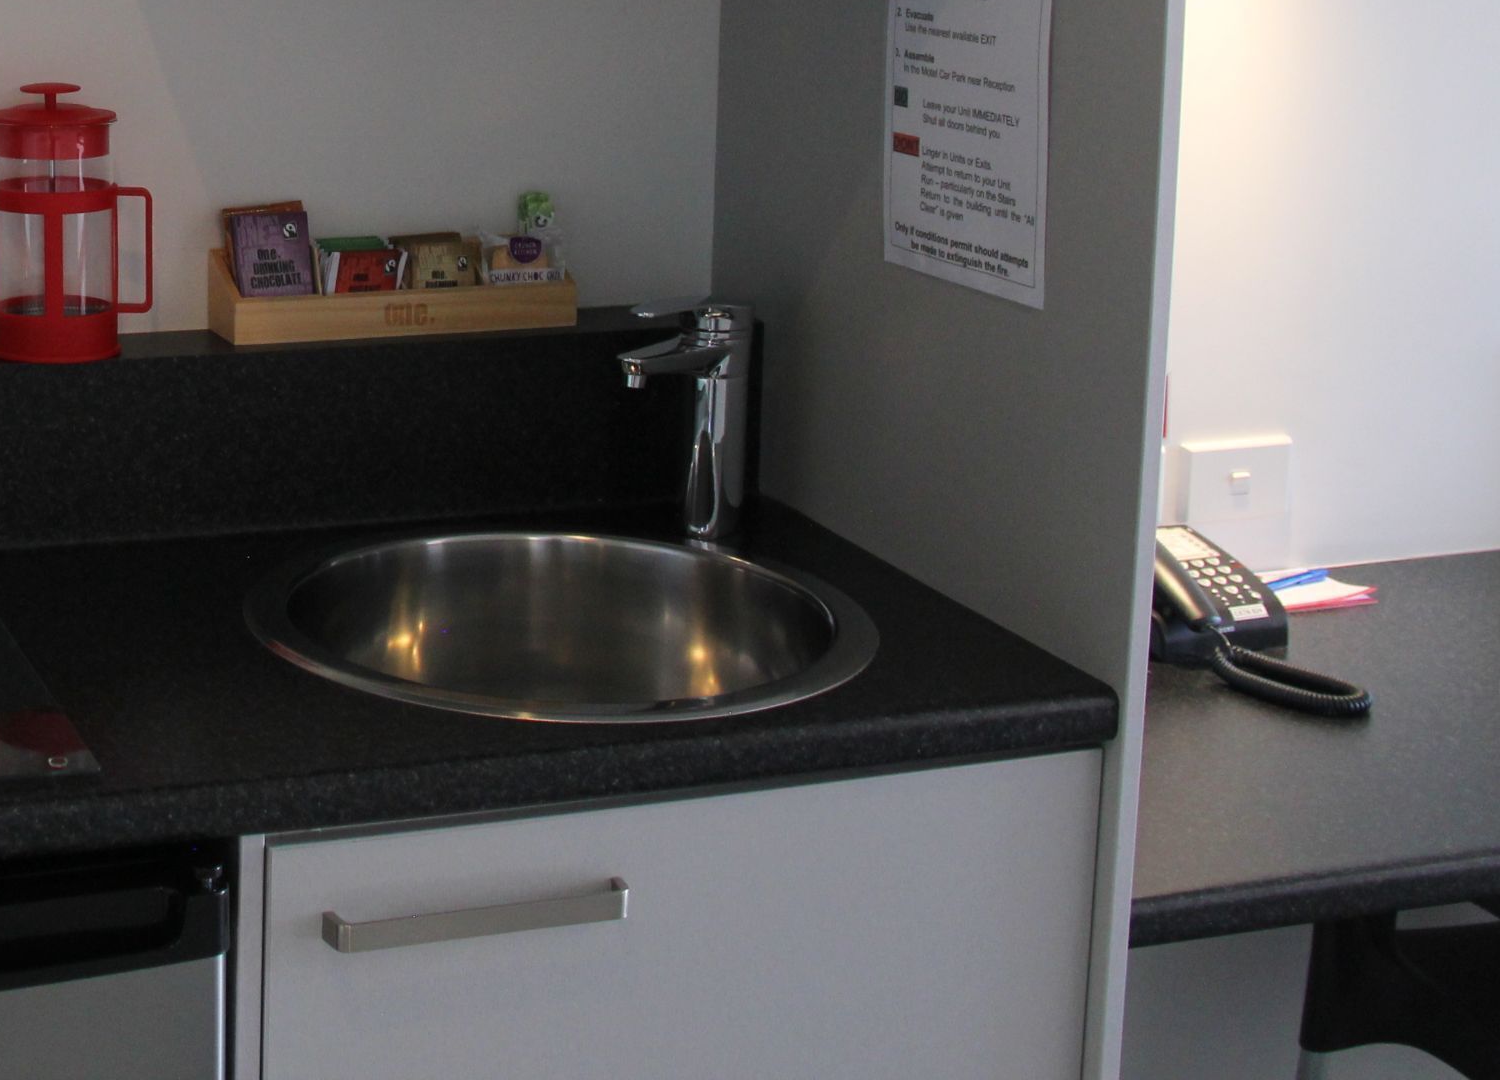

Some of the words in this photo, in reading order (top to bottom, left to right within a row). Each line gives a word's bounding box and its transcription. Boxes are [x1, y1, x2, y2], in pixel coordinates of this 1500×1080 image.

[906, 8, 934, 22] Evacuate
[905, 22, 916, 32] Use
[918, 24, 927, 33] the
[928, 27, 950, 38] nearest
[952, 31, 979, 43] available
[980, 34, 997, 46] EXIT
[904, 50, 935, 63] Assemble
[911, 65, 920, 75] the
[921, 67, 937, 78] Motel
[938, 70, 950, 80] Car
[952, 72, 966, 83] Park
[967, 77, 981, 86] near
[983, 78, 1015, 92] Reception
[923, 99, 941, 111] Leave
[942, 105, 956, 115] your
[957, 107, 970, 117] Unit
[972, 109, 1020, 128] IMMEDIATELY
[923, 113, 937, 125] Shut
[947, 119, 965, 131] doors
[966, 123, 987, 136] behind
[922, 146, 940, 159] Linger
[942, 151, 948, 159] in
[950, 152, 965, 165] Units
[967, 157, 973, 166] or
[921, 161, 945, 176] Attempt
[946, 167, 952, 177] to
[954, 170, 973, 183] return
[974, 172, 980, 183] to
[982, 177, 996, 188] your
[921, 174, 933, 185] Run
[940, 181, 975, 198] particularly
[975, 189, 984, 199] on
[986, 190, 996, 201] the
[997, 193, 1016, 207] Stairs
[920, 188, 940, 201] Return
[944, 194, 950, 204] to
[953, 196, 963, 207] the
[966, 200, 991, 217] building
[994, 207, 1008, 219] until
[1011, 210, 1021, 222] the
[946, 210, 963, 222] given
[895, 221, 909, 236] Only
[915, 229, 949, 245] conditions
[950, 238, 973, 253] permit
[974, 245, 998, 260] should
[1000, 252, 1029, 269] attempts
[911, 239, 919, 250] be
[920, 243, 937, 256] made
[938, 248, 945, 259] to
[946, 251, 982, 269] extinguish
[984, 261, 995, 273] the
[253, 260, 295, 275] DRINKING
[490, 271, 521, 283] CHUNKY
[522, 271, 544, 281] CHOC
[250, 272, 302, 290] CHOCOLATE
